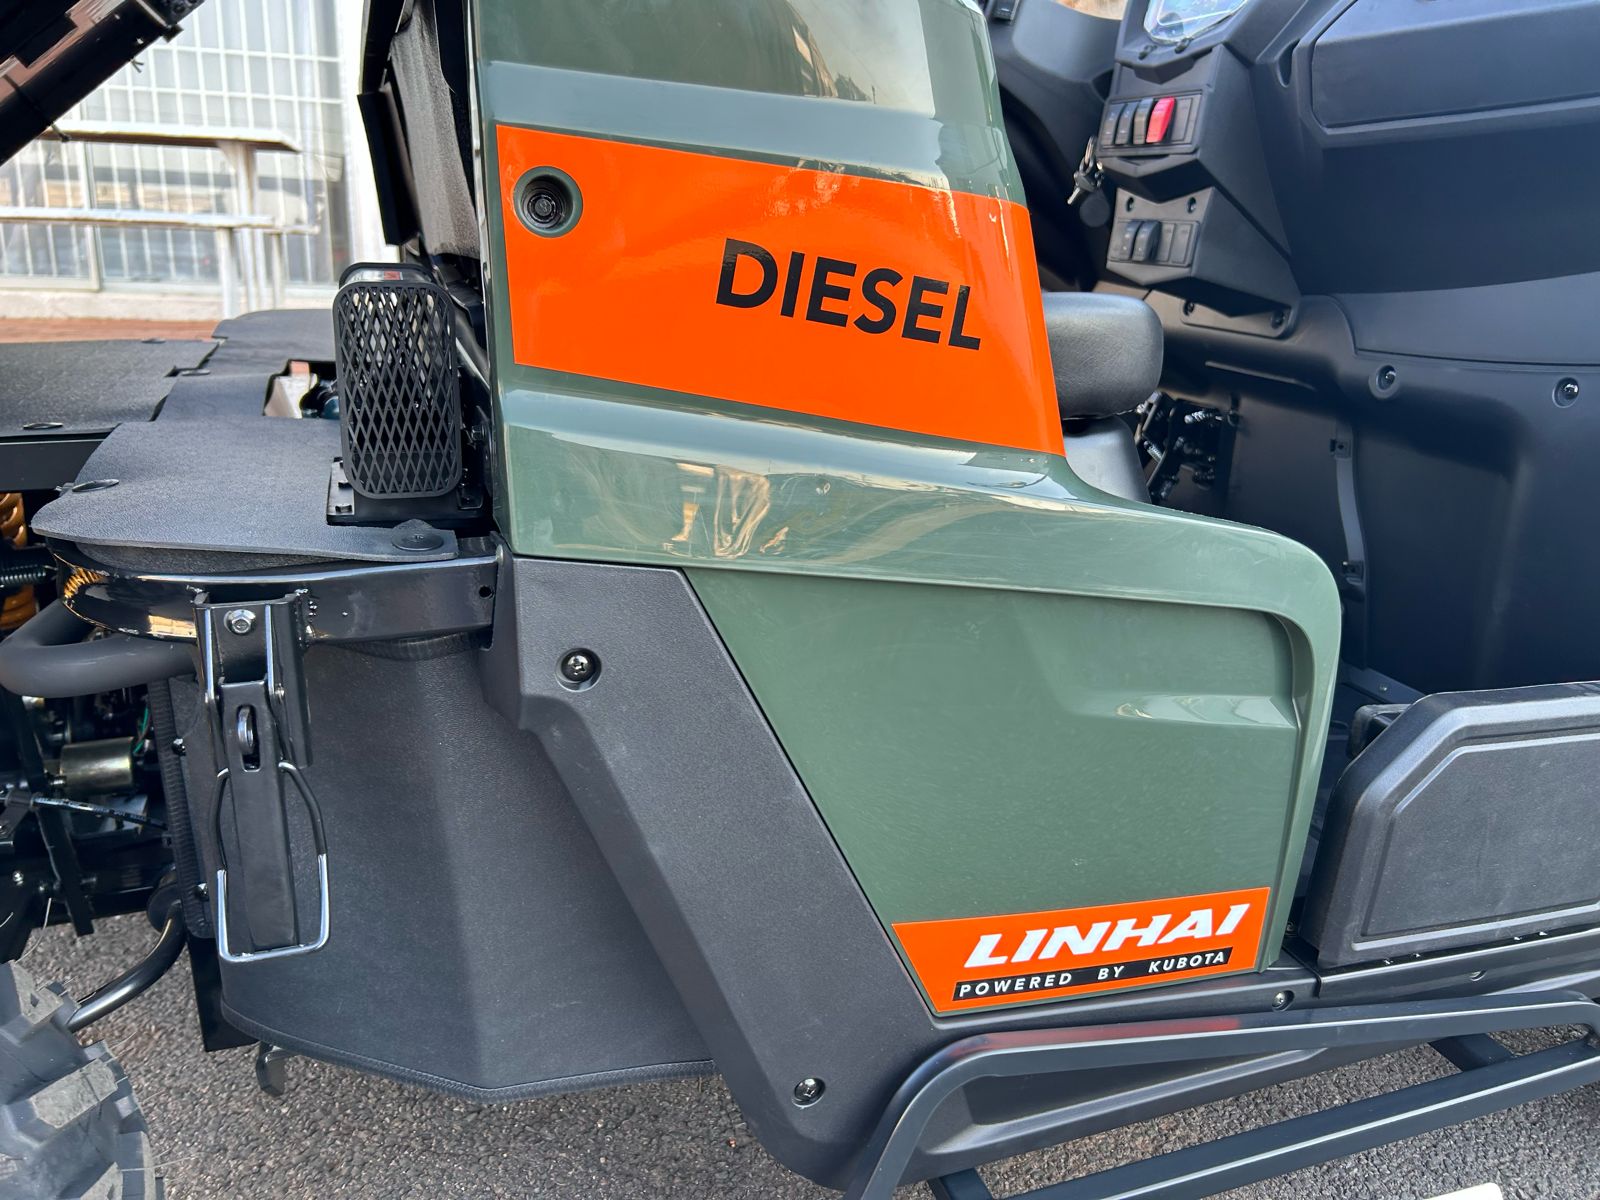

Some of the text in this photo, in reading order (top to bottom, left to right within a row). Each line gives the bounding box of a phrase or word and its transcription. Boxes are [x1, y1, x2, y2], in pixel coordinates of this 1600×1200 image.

[716, 238, 981, 350] DIESEL
[964, 903, 1250, 967] LINHAI
[959, 951, 1225, 998] POWERED BY KUBOTA
